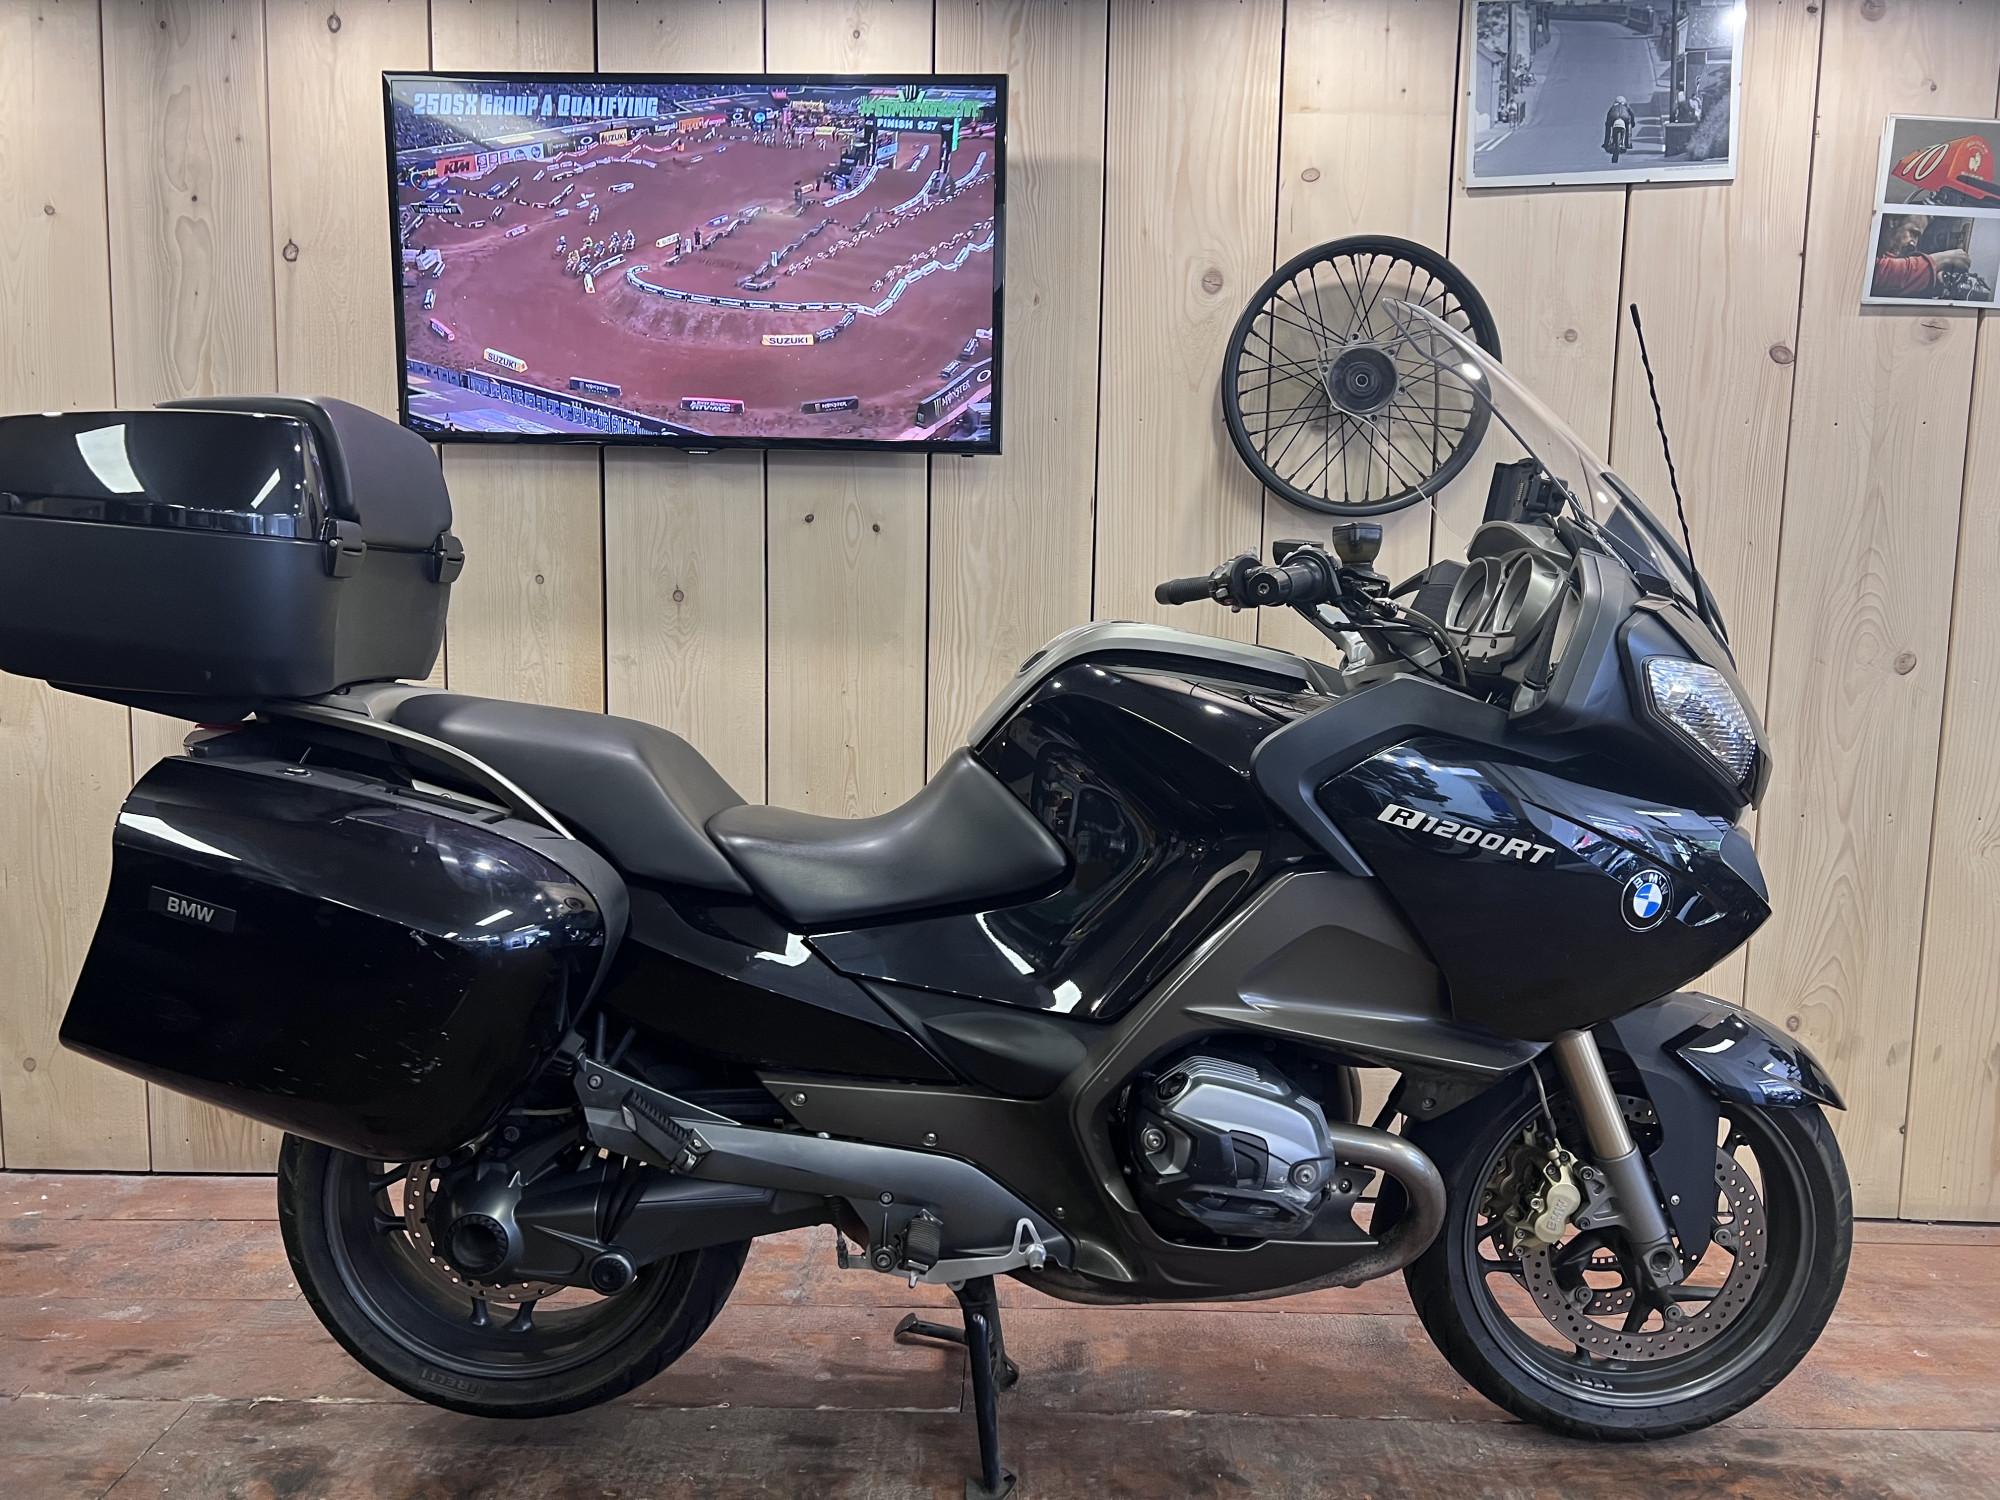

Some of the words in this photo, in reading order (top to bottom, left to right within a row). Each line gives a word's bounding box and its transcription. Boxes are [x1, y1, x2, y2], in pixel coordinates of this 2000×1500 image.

[413, 93, 479, 116] 250SX
[481, 93, 539, 116] GROUP
[540, 94, 556, 117] A
[557, 94, 659, 118] QUALIFYING
[443, 160, 471, 176] KTM
[769, 335, 809, 345] SUZUKI
[487, 351, 518, 370] SUZUKI
[1632, 873, 1669, 897] BMW
[167, 896, 215, 922] BMW
[1546, 1199, 1568, 1231] BMW
